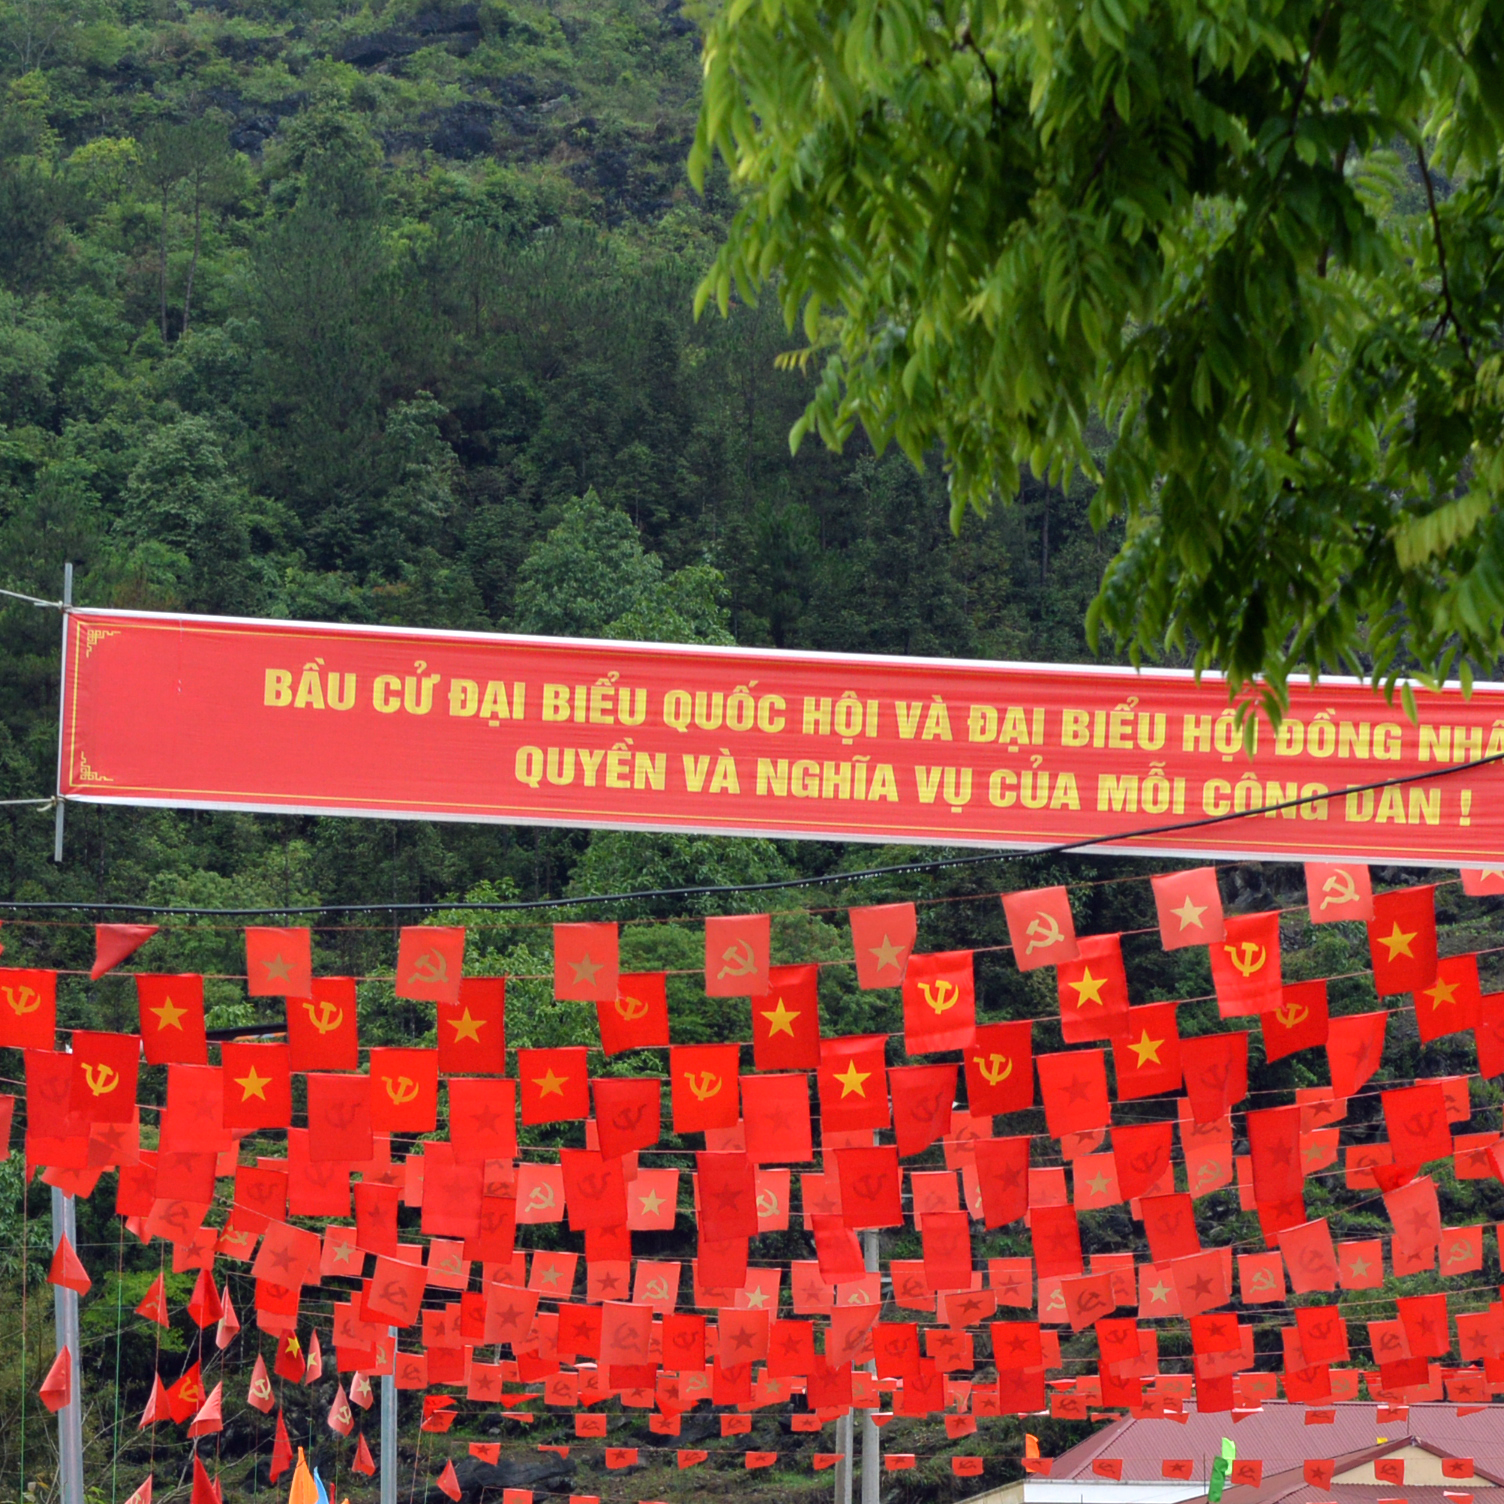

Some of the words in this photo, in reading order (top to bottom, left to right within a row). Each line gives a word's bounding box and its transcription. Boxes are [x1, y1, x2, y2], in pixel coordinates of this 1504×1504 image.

[263, 657, 357, 711] BẦU
[372, 658, 439, 716] CỬ
[448, 678, 527, 728] ĐẠI
[541, 670, 648, 727] BIỂU
[663, 680, 787, 735] QUỐC
[802, 690, 879, 744] HỘI
[895, 693, 954, 743] VÀ
[968, 705, 1044, 755] ĐẠI
[1061, 696, 1167, 751] BIỂU
[1274, 707, 1402, 761] ĐỒNG
[514, 736, 667, 791] QUYỀN
[682, 746, 742, 795] VÀ
[754, 752, 900, 803] NGHĨA
[914, 766, 974, 814] VỤ
[989, 752, 1081, 811] CỦA
[1097, 760, 1186, 816] MỖI
[1202, 771, 1330, 821] CÔNG
[1345, 777, 1442, 827] DÂN
[1459, 789, 1473, 828] !
